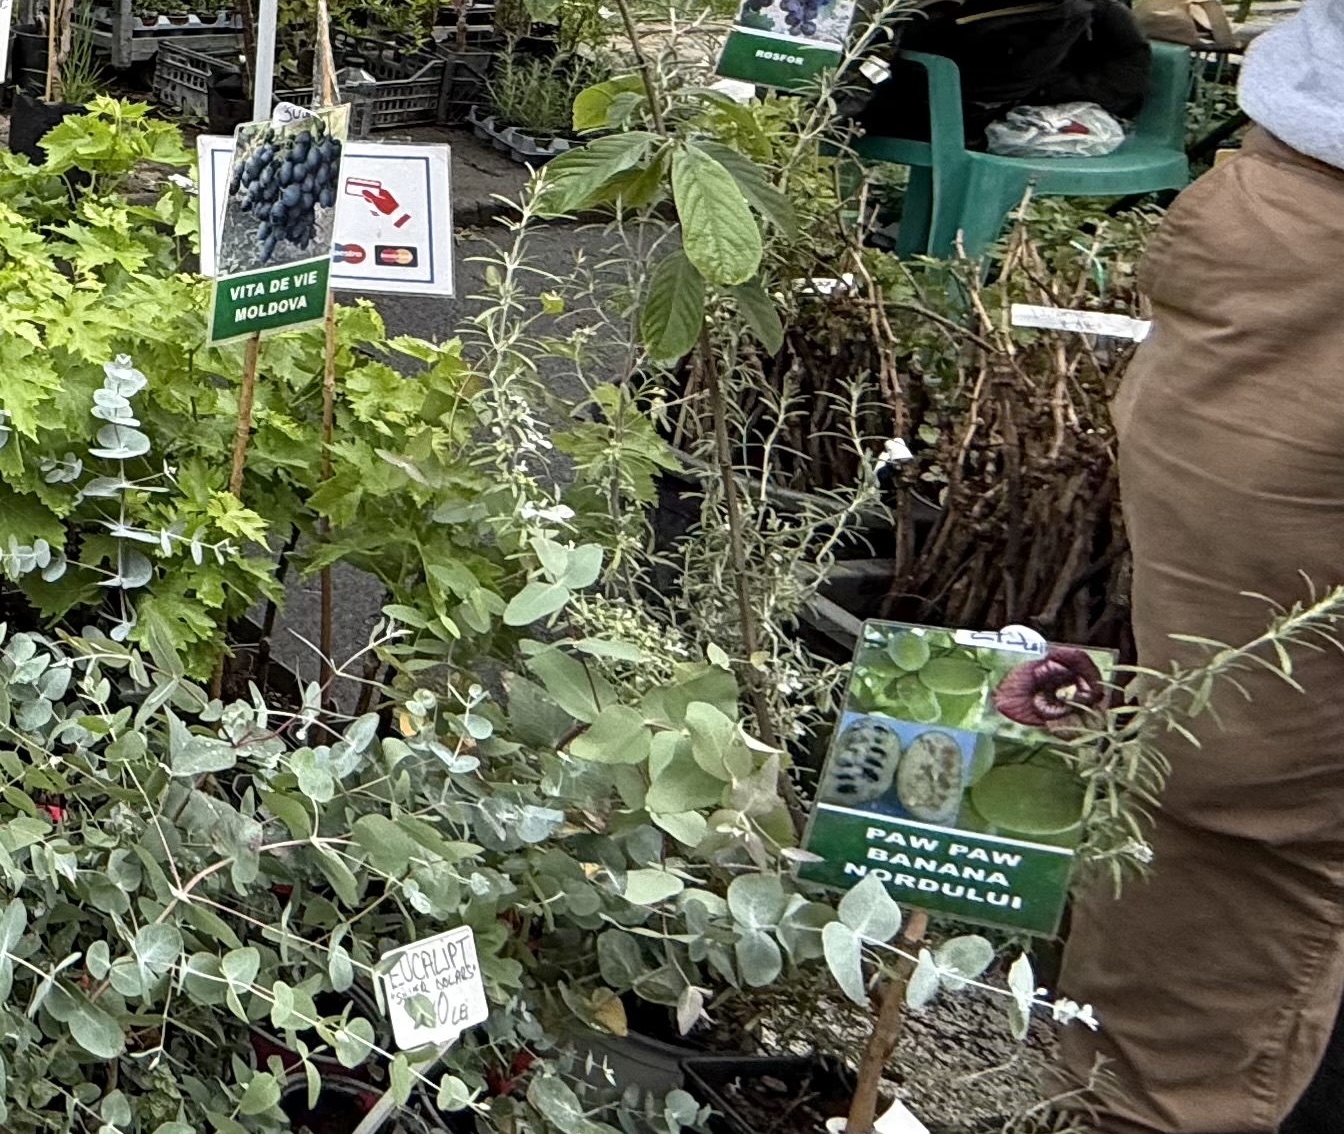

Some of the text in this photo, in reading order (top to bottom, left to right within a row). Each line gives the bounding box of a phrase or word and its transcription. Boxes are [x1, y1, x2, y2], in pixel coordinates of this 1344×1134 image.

[229, 270, 318, 302] VITA DE VIE
[235, 295, 308, 323] MOLDOVA
[866, 826, 1022, 868] PAW PAW
[866, 847, 1011, 888] BANANA
[844, 862, 1023, 910] NORDULUI
